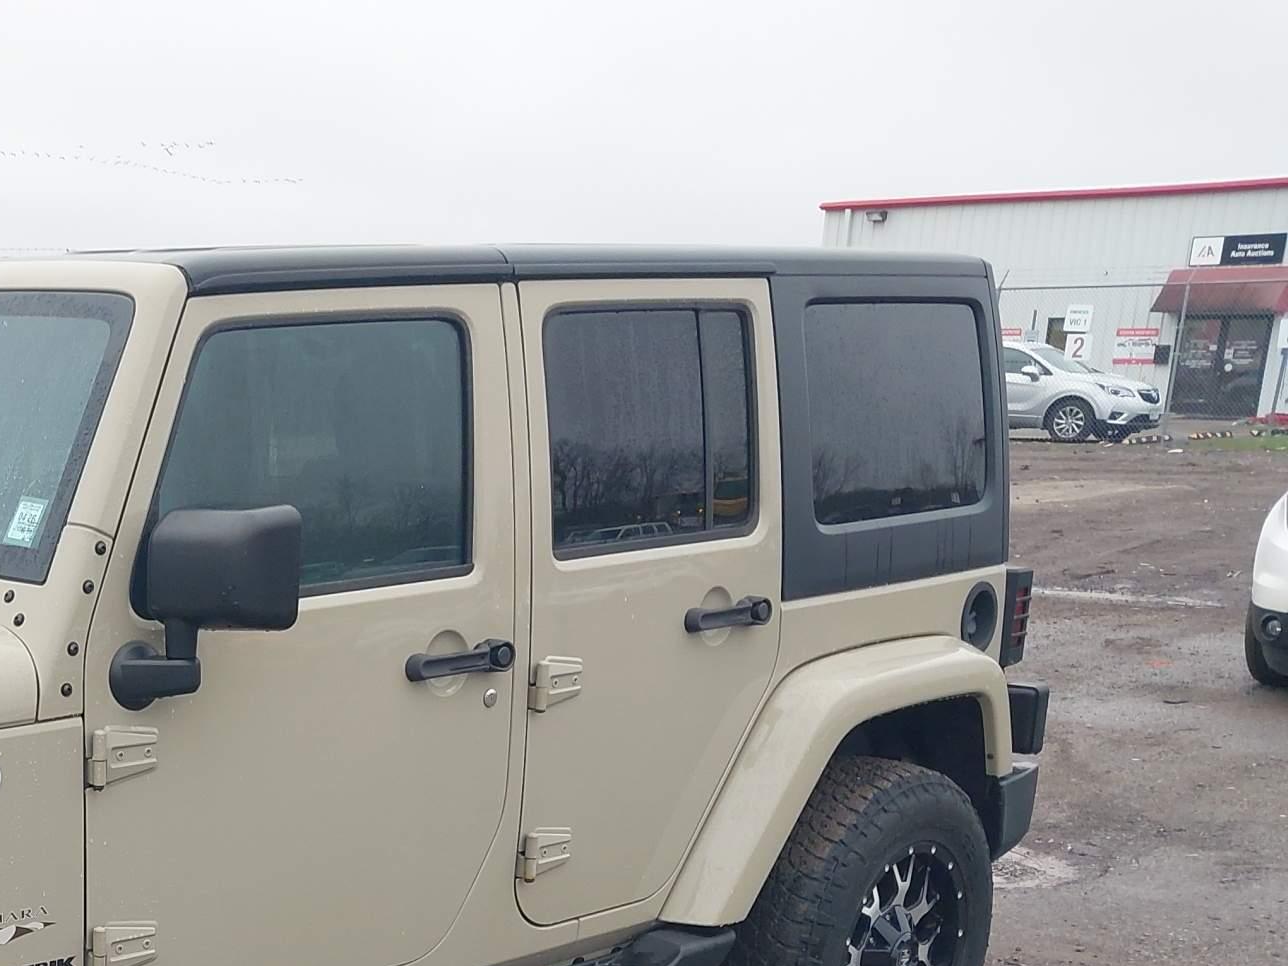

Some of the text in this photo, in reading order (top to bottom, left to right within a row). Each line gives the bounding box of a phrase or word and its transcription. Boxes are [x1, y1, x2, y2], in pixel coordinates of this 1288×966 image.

[1238, 242, 1269, 250] Insurance
[1247, 249, 1274, 257] Auctions
[1072, 337, 1085, 358] 2
